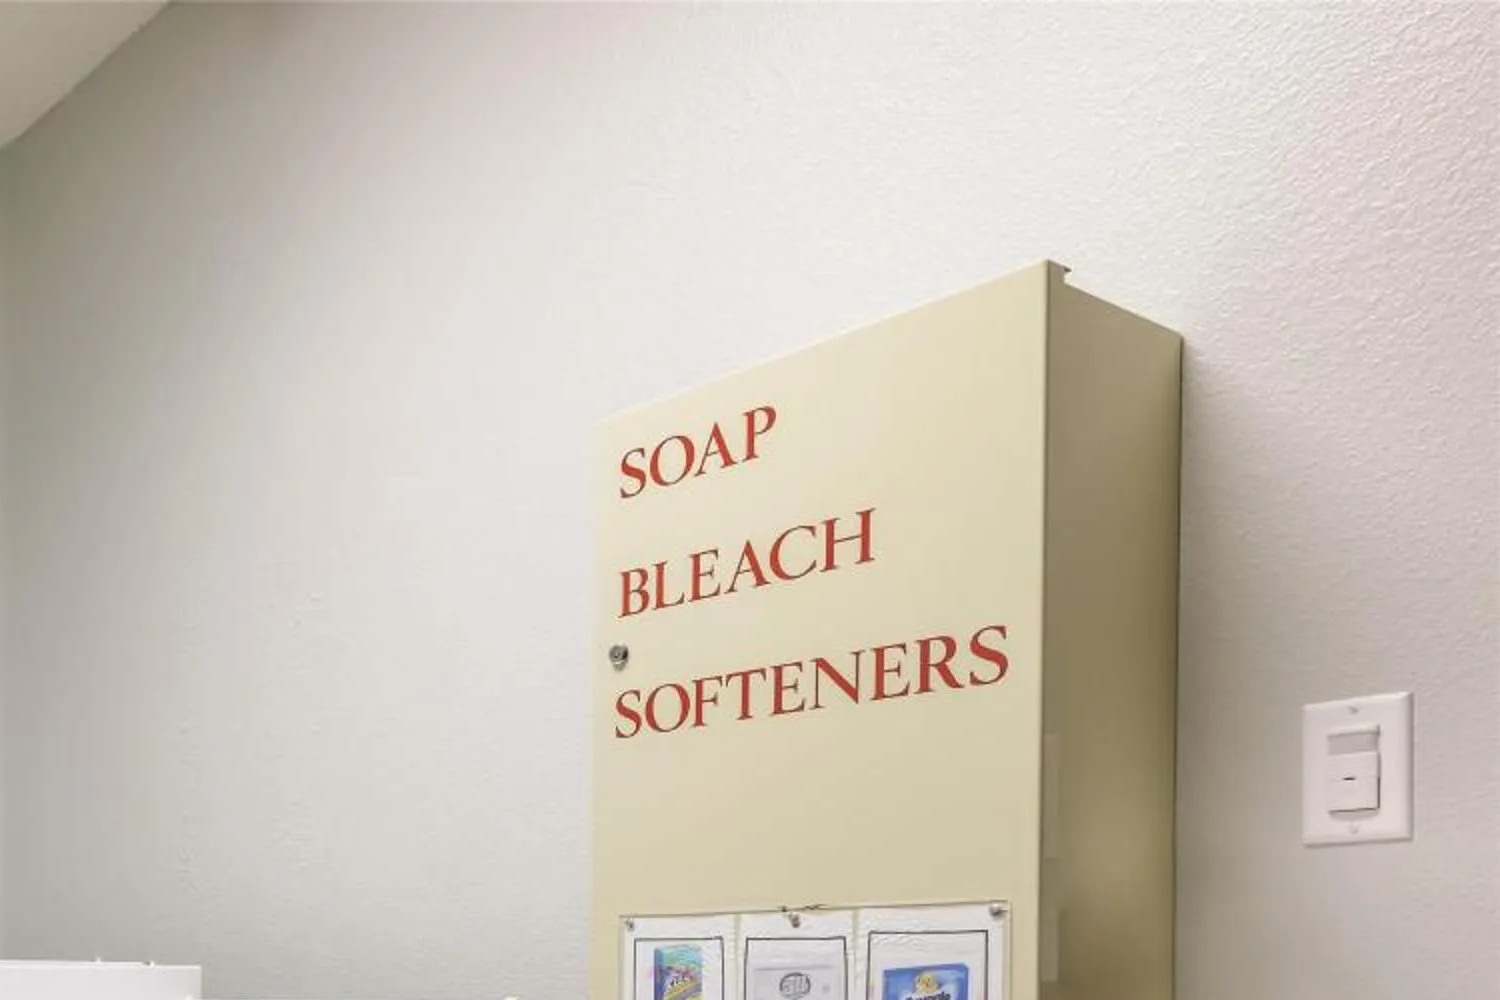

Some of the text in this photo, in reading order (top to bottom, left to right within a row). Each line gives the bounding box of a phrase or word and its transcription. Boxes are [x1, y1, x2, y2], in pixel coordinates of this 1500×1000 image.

[619, 405, 777, 499] SOAP
[618, 508, 876, 618] BLEACH
[614, 625, 1010, 739] SOFTENERS
